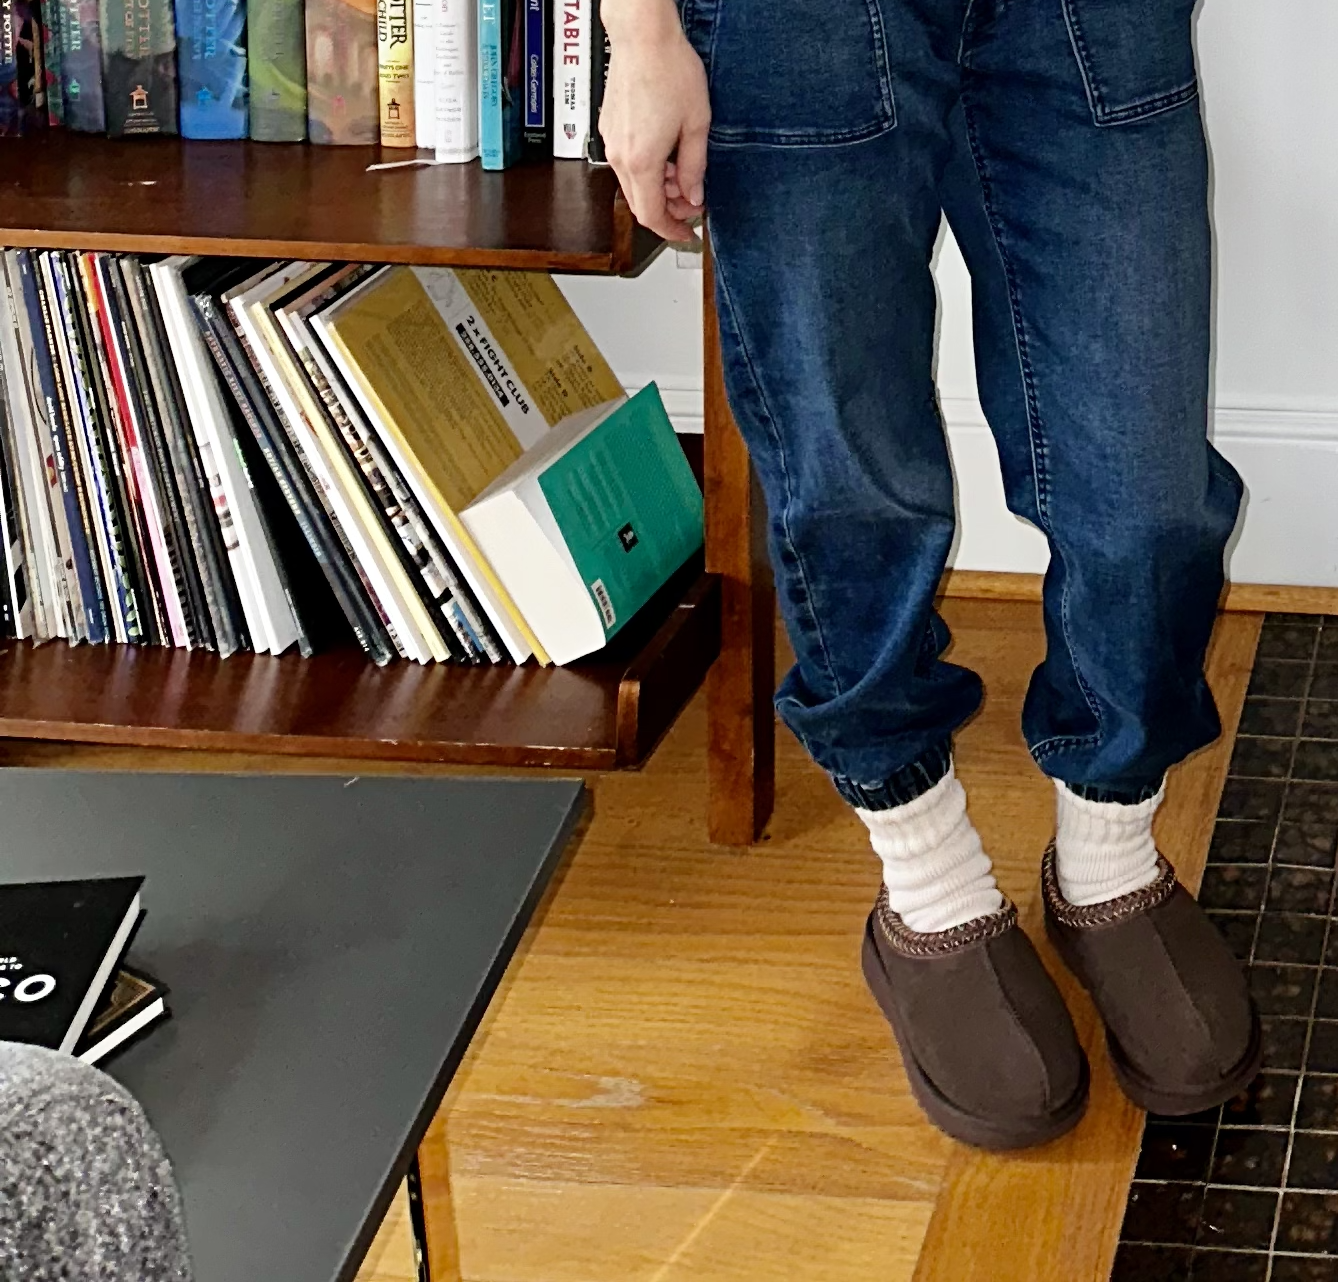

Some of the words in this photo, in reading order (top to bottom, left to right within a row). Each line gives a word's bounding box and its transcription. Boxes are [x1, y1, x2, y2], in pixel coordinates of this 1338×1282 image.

[378, 0, 388, 42] CHILD
[563, 0, 580, 66] TABLE
[466, 315, 475, 326] 2
[479, 336, 510, 380] FIGHT
[505, 377, 530, 415] CLUB
